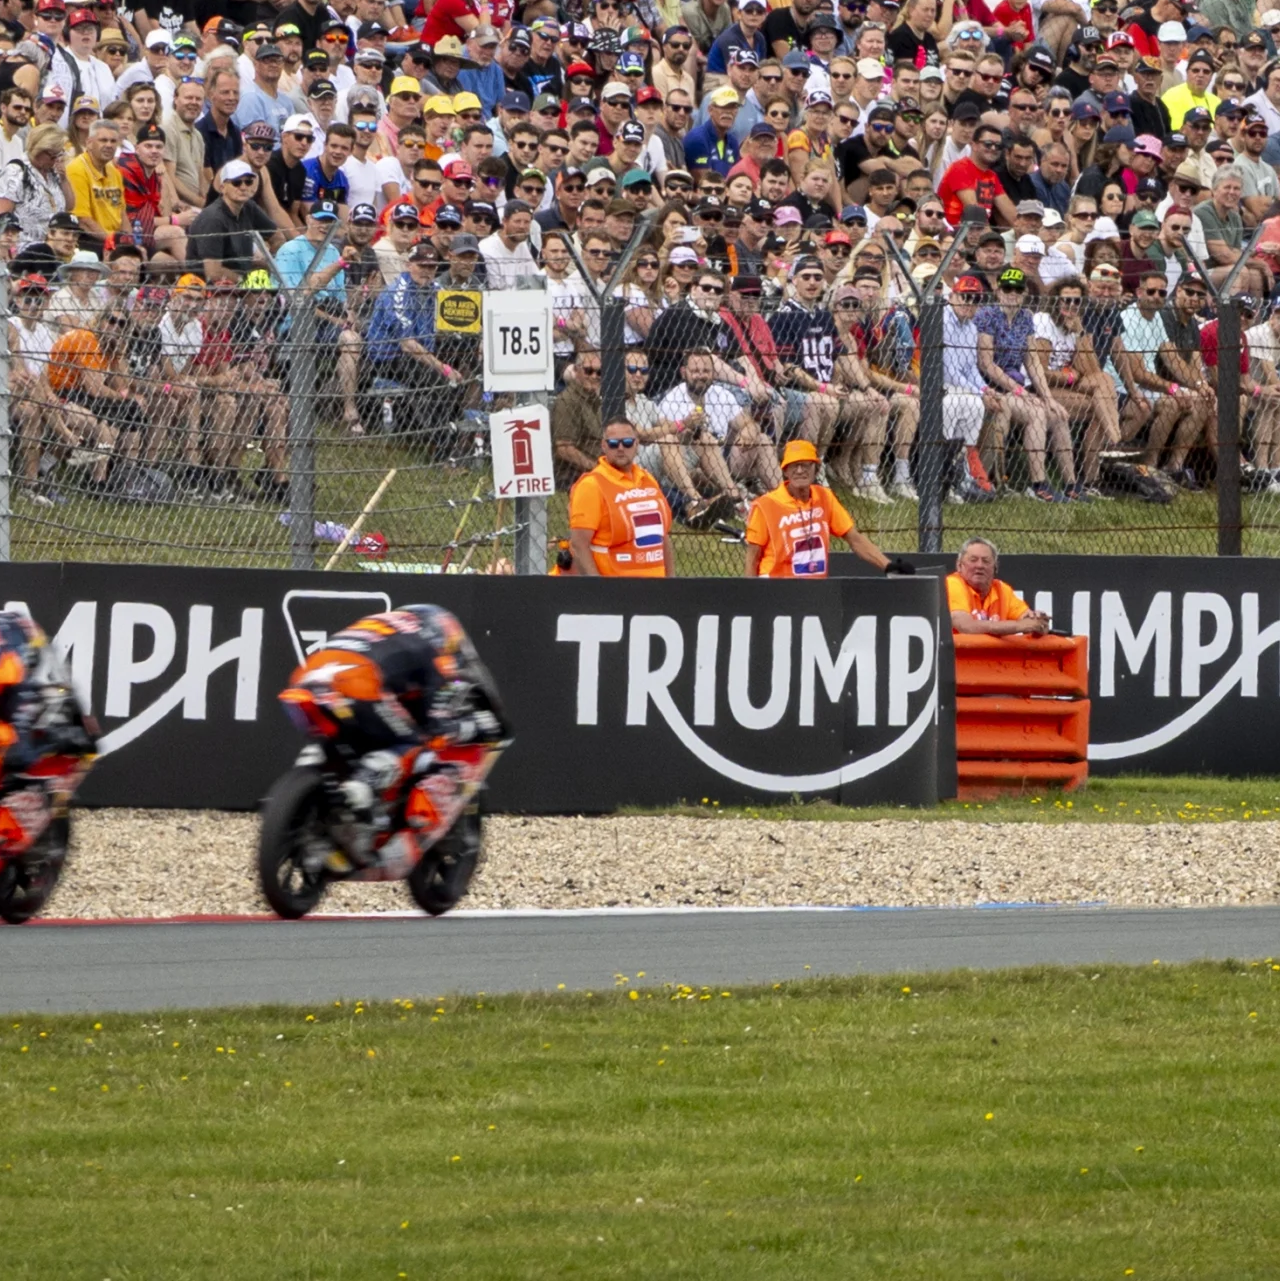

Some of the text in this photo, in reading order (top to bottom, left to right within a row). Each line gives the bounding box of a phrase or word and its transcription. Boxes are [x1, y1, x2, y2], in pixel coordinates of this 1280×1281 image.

[499, 326, 540, 355] T8.5
[516, 477, 552, 494] FIRE
[557, 613, 940, 792] TRIUMP
